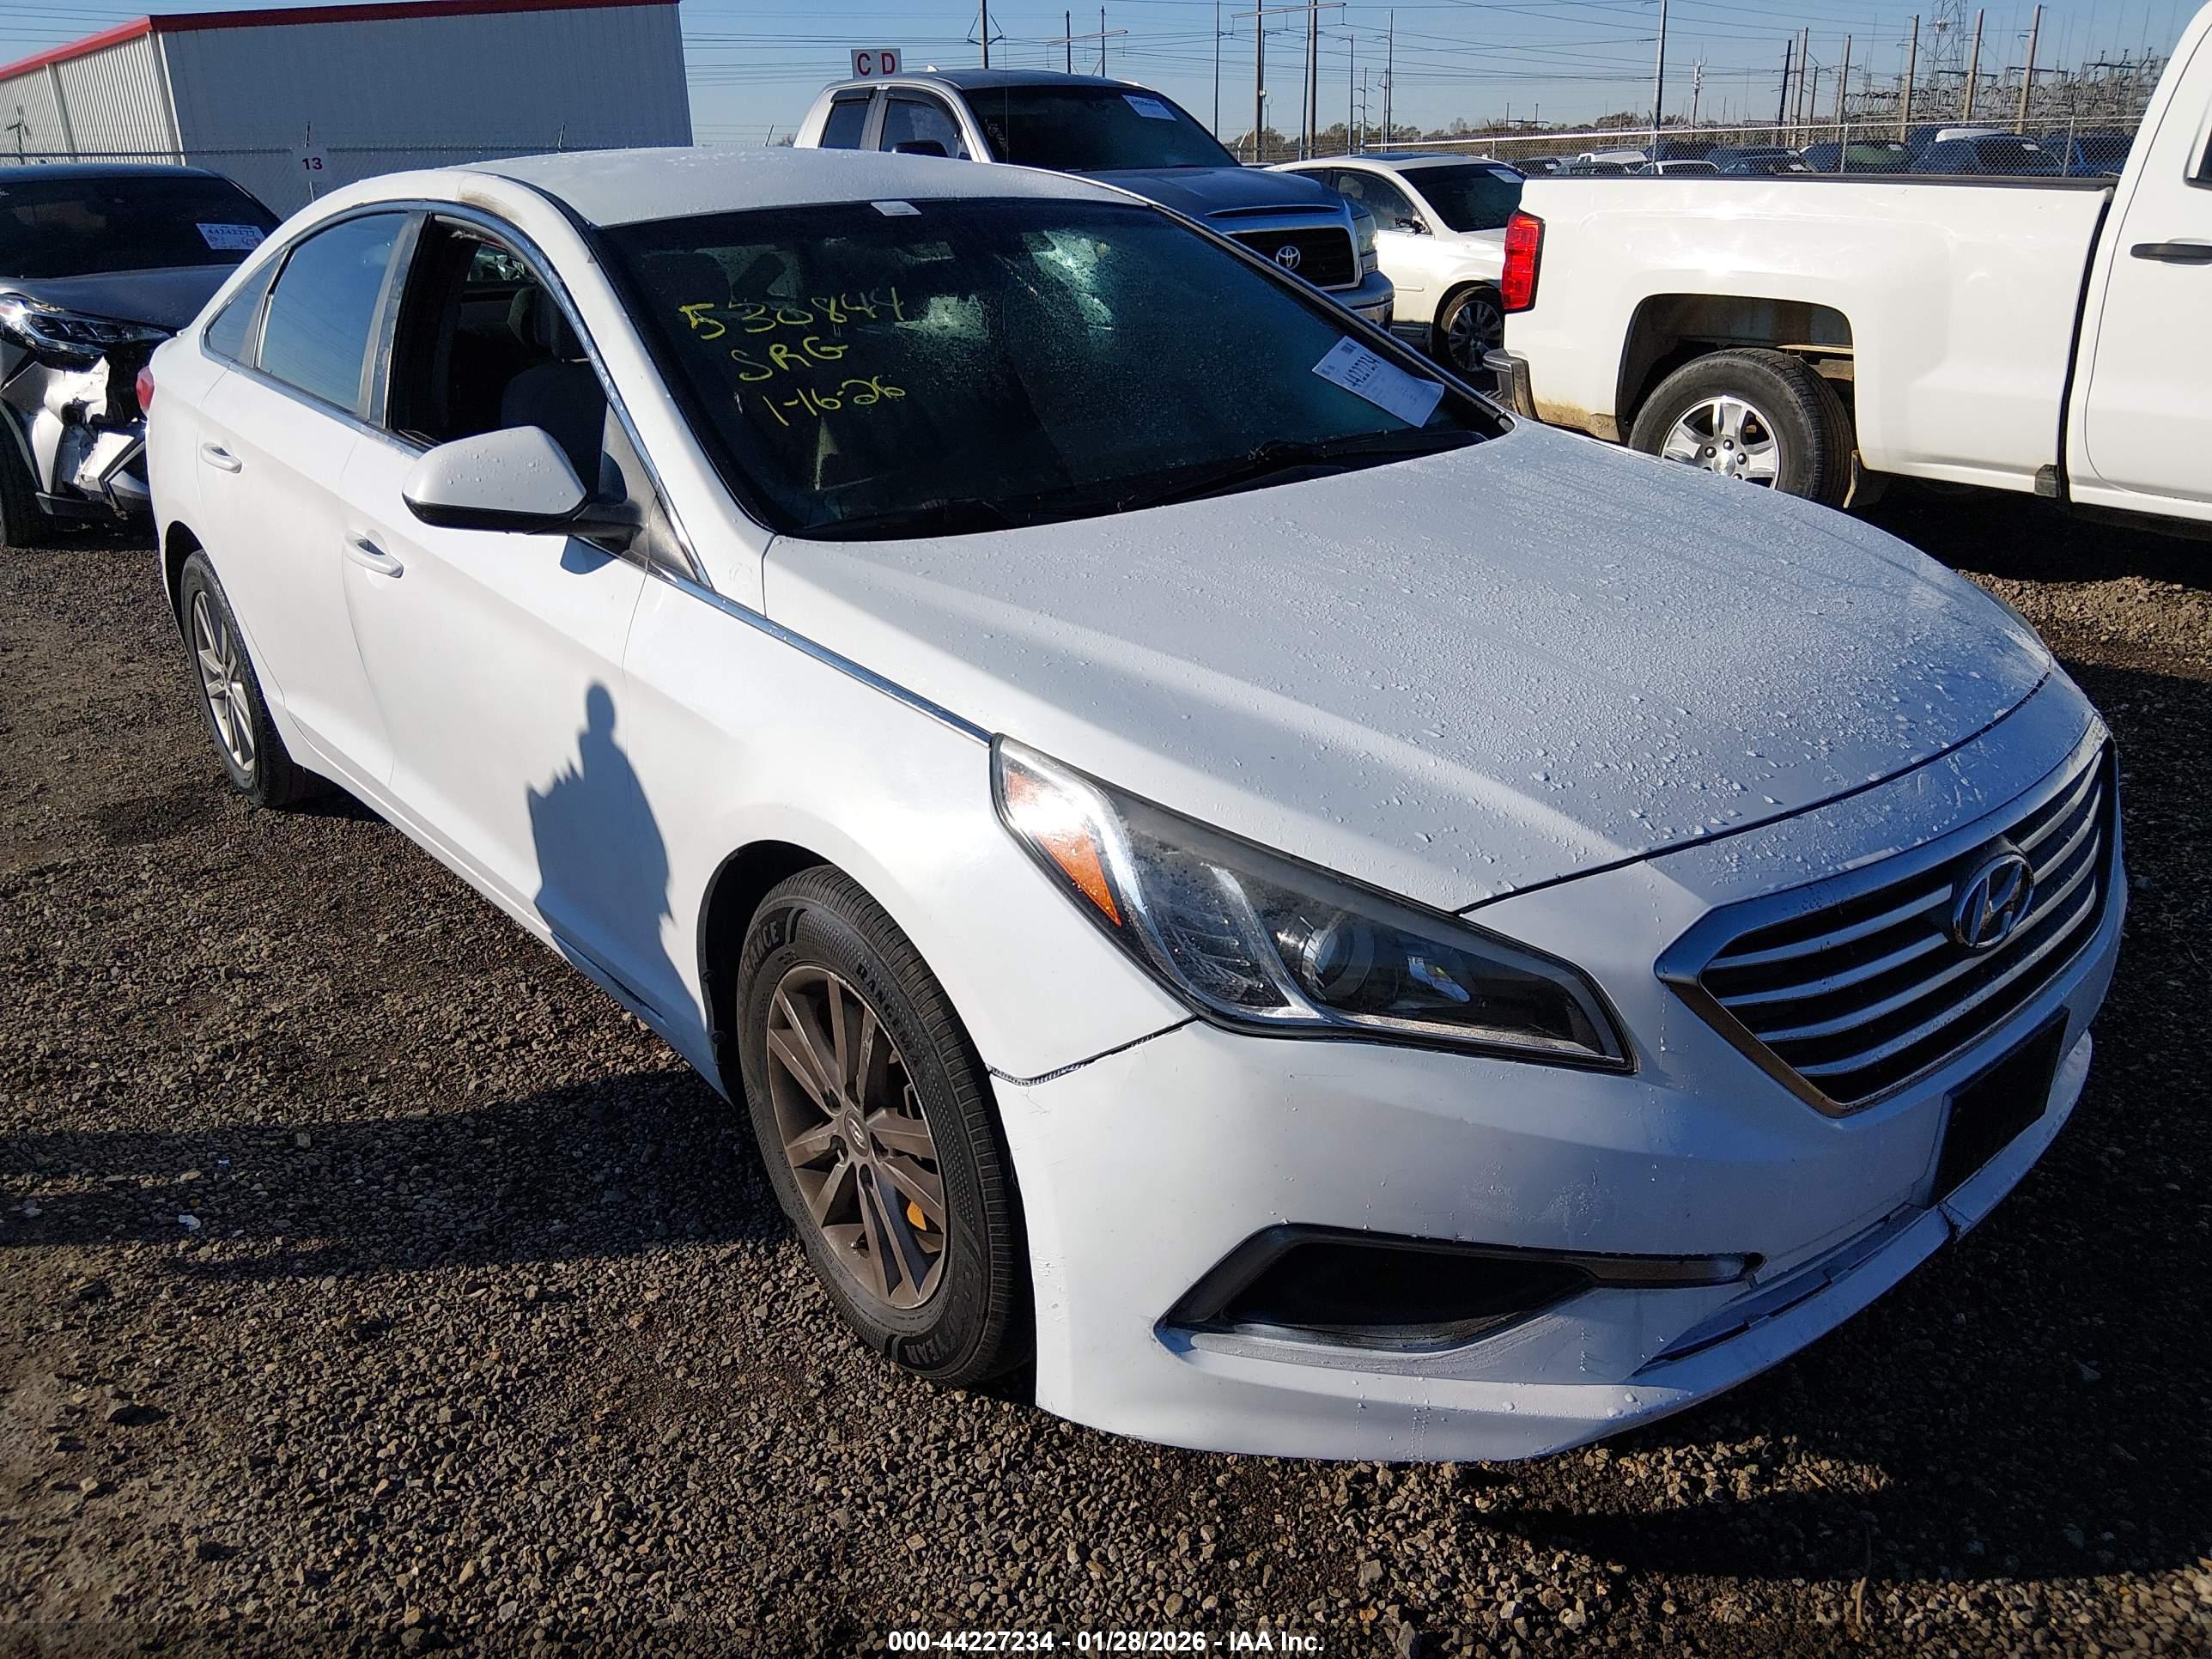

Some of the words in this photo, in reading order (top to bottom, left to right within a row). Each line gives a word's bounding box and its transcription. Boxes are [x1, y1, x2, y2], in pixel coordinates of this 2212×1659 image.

[857, 52, 872, 76] C
[881, 52, 896, 76] D
[301, 157, 323, 170] 13
[731, 336, 849, 381] SRG
